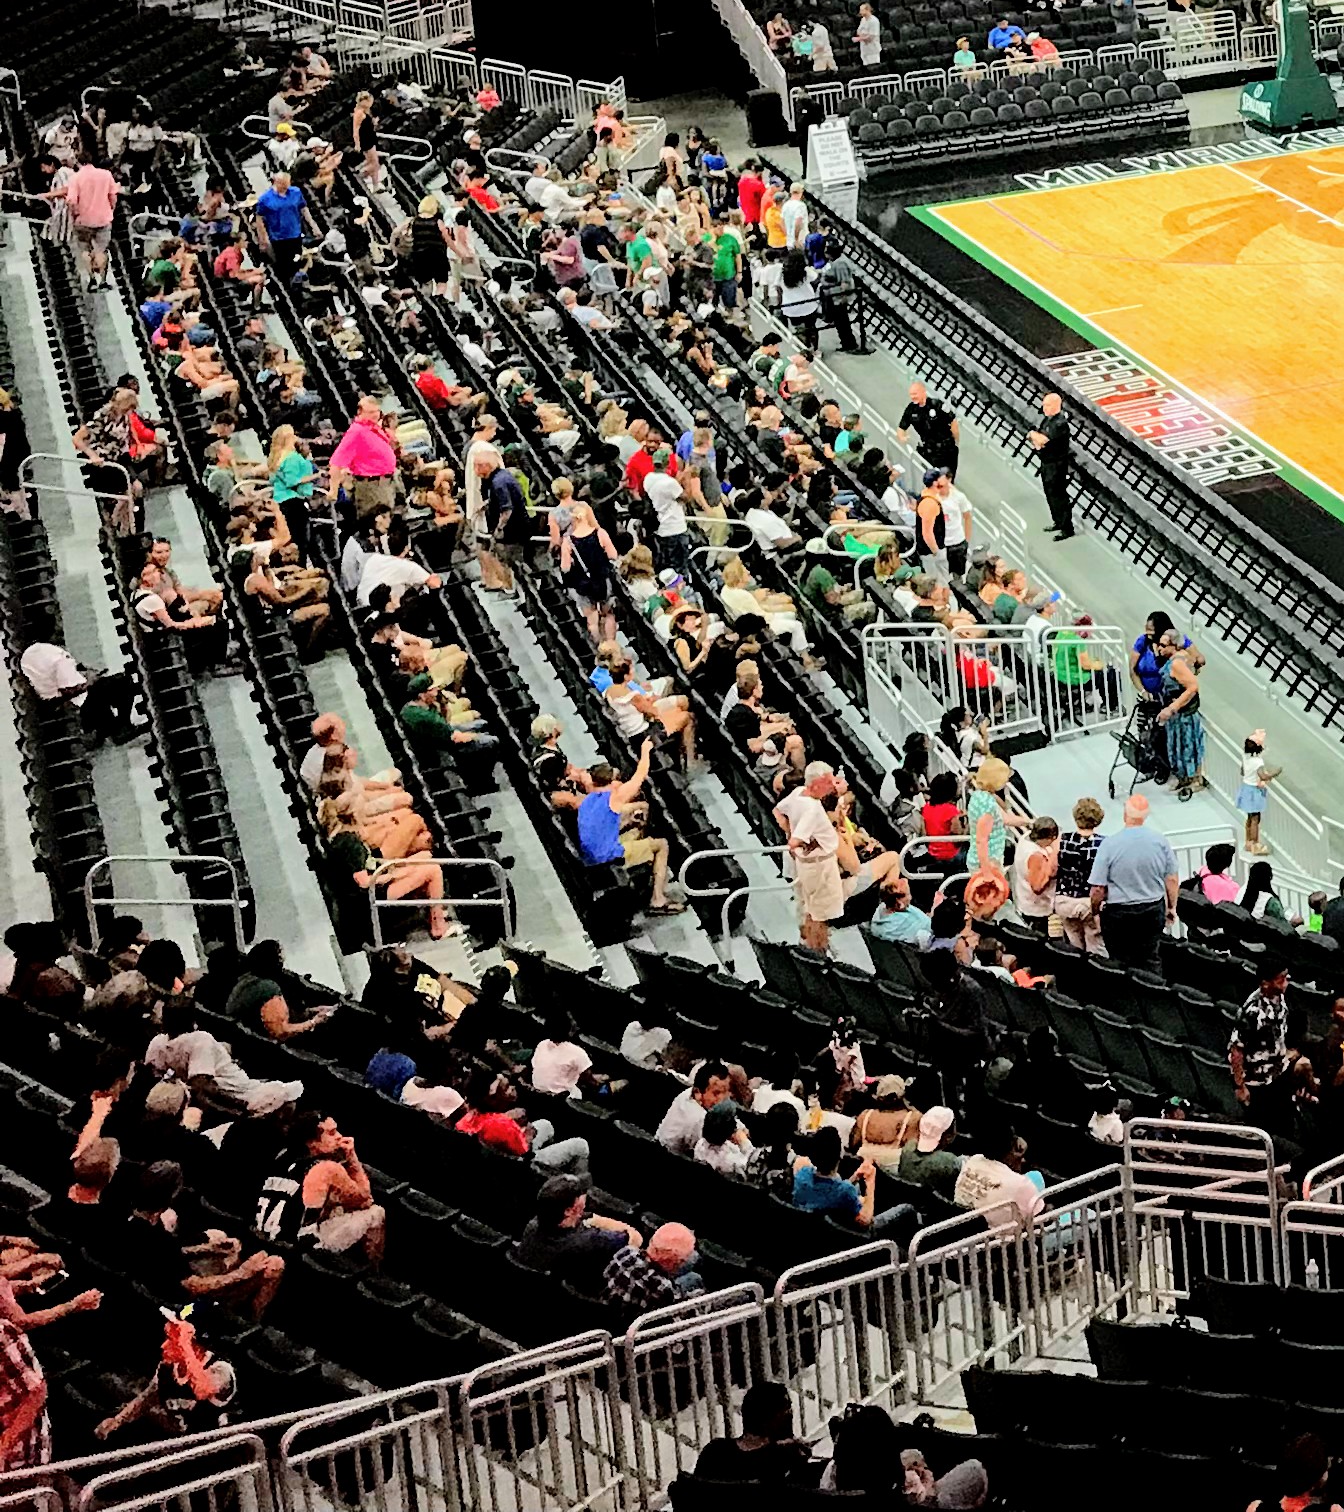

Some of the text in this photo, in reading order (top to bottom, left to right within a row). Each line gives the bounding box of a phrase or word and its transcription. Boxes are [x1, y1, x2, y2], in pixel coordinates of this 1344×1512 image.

[1041, 347, 1283, 486] FEAR THE DEER
